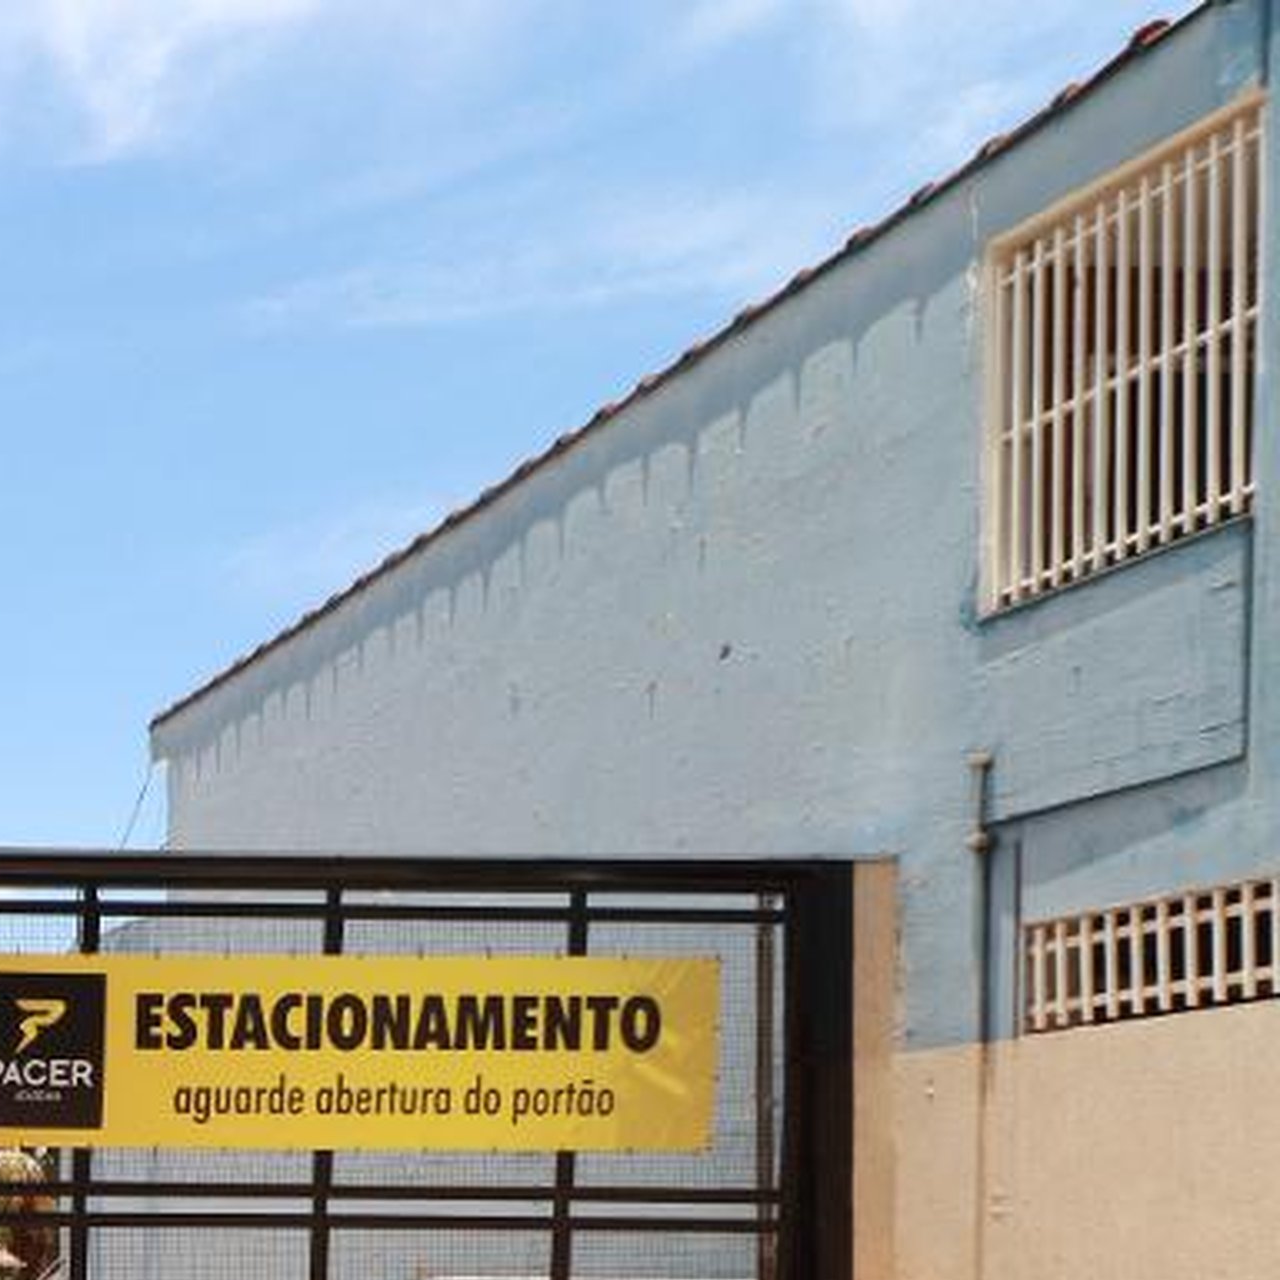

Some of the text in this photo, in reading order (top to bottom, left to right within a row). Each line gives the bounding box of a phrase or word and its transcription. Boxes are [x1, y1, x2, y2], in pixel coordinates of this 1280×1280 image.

[135, 992, 662, 1055] ESTACIONAMENTO
[173, 1074, 616, 1125] aguarde abertura do portão
